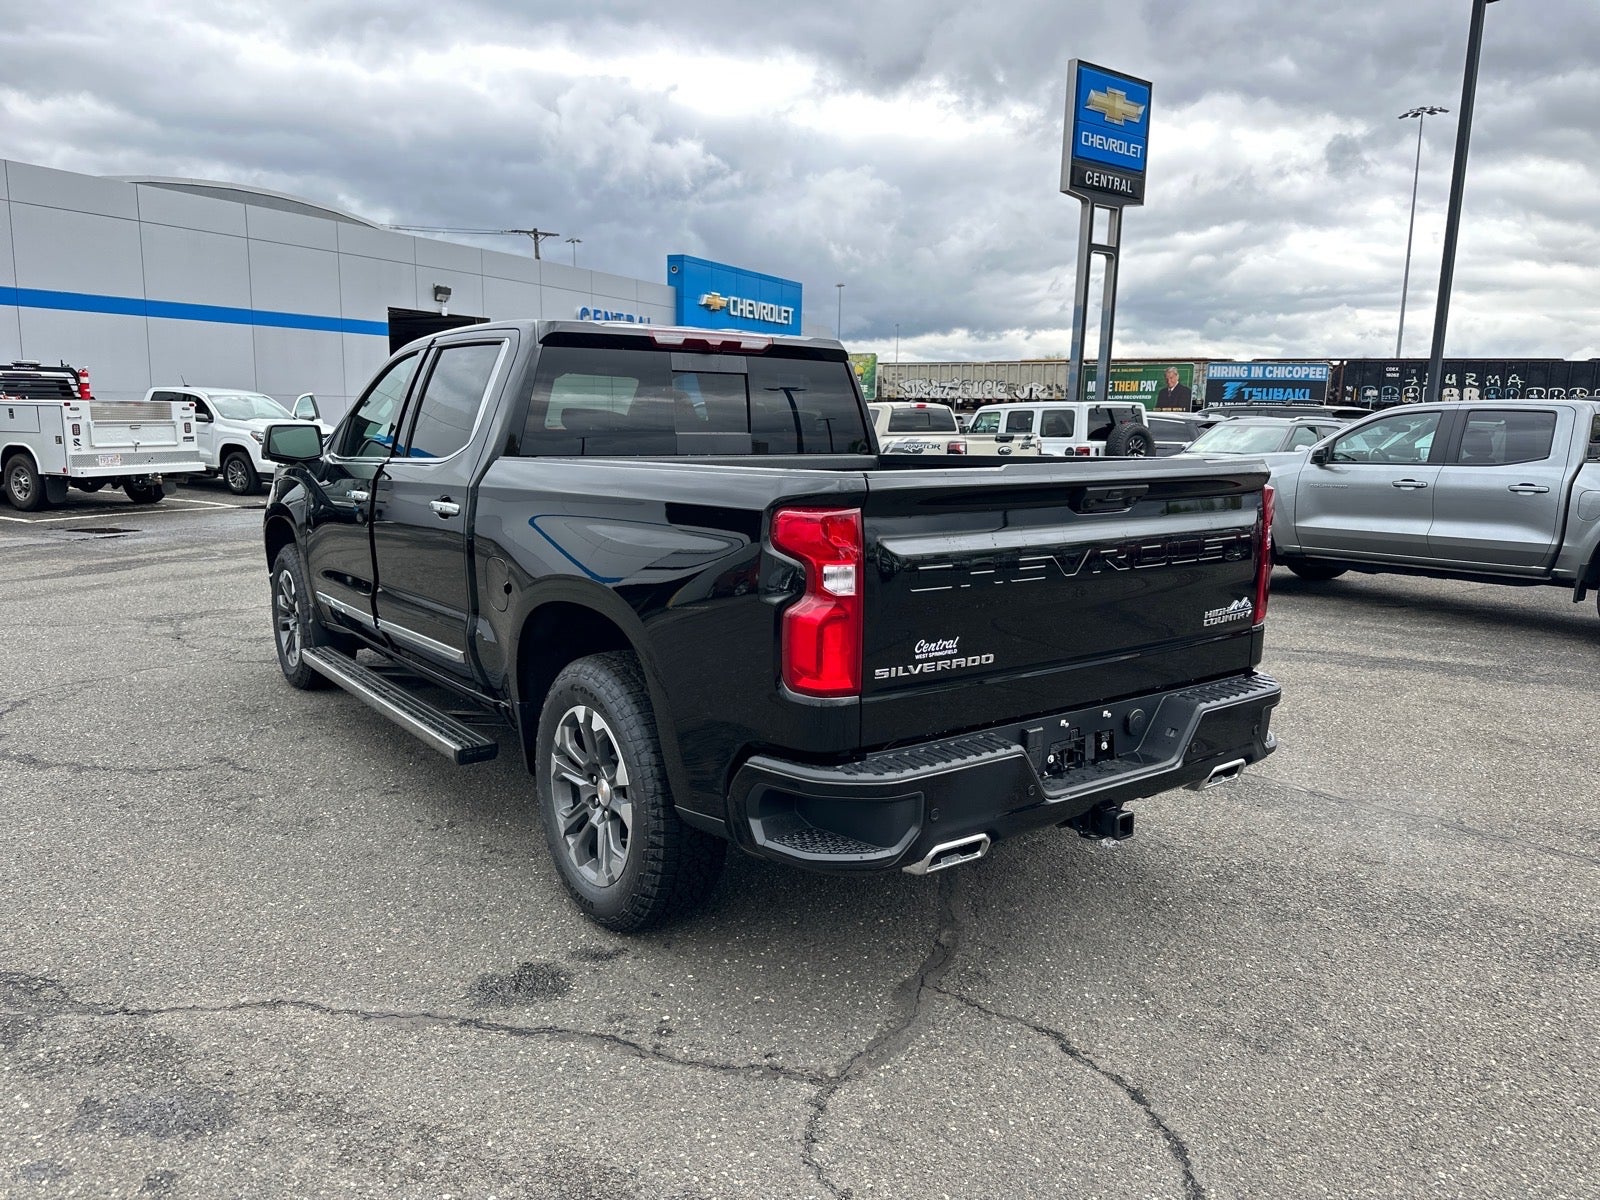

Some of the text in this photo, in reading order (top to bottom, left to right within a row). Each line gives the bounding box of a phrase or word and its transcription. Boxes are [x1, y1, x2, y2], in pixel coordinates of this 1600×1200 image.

[1081, 131, 1142, 158] CHEVROLET
[1085, 171, 1133, 193] CENTRAL
[729, 296, 794, 325] CHEVROLET
[1208, 365, 1327, 379] HIRING IN CHICOPEE!
[1087, 380, 1157, 392] ME THEM PAY
[1240, 387, 1310, 400] TSUBAKI
[902, 443, 942, 451] RAPTOR
[1203, 609, 1252, 627] COUNTRY
[1204, 607, 1231, 619] HIGH
[914, 636, 960, 654] Central
[928, 648, 958, 658] SPRINGFIELD
[874, 653, 995, 680] SILVERADO
